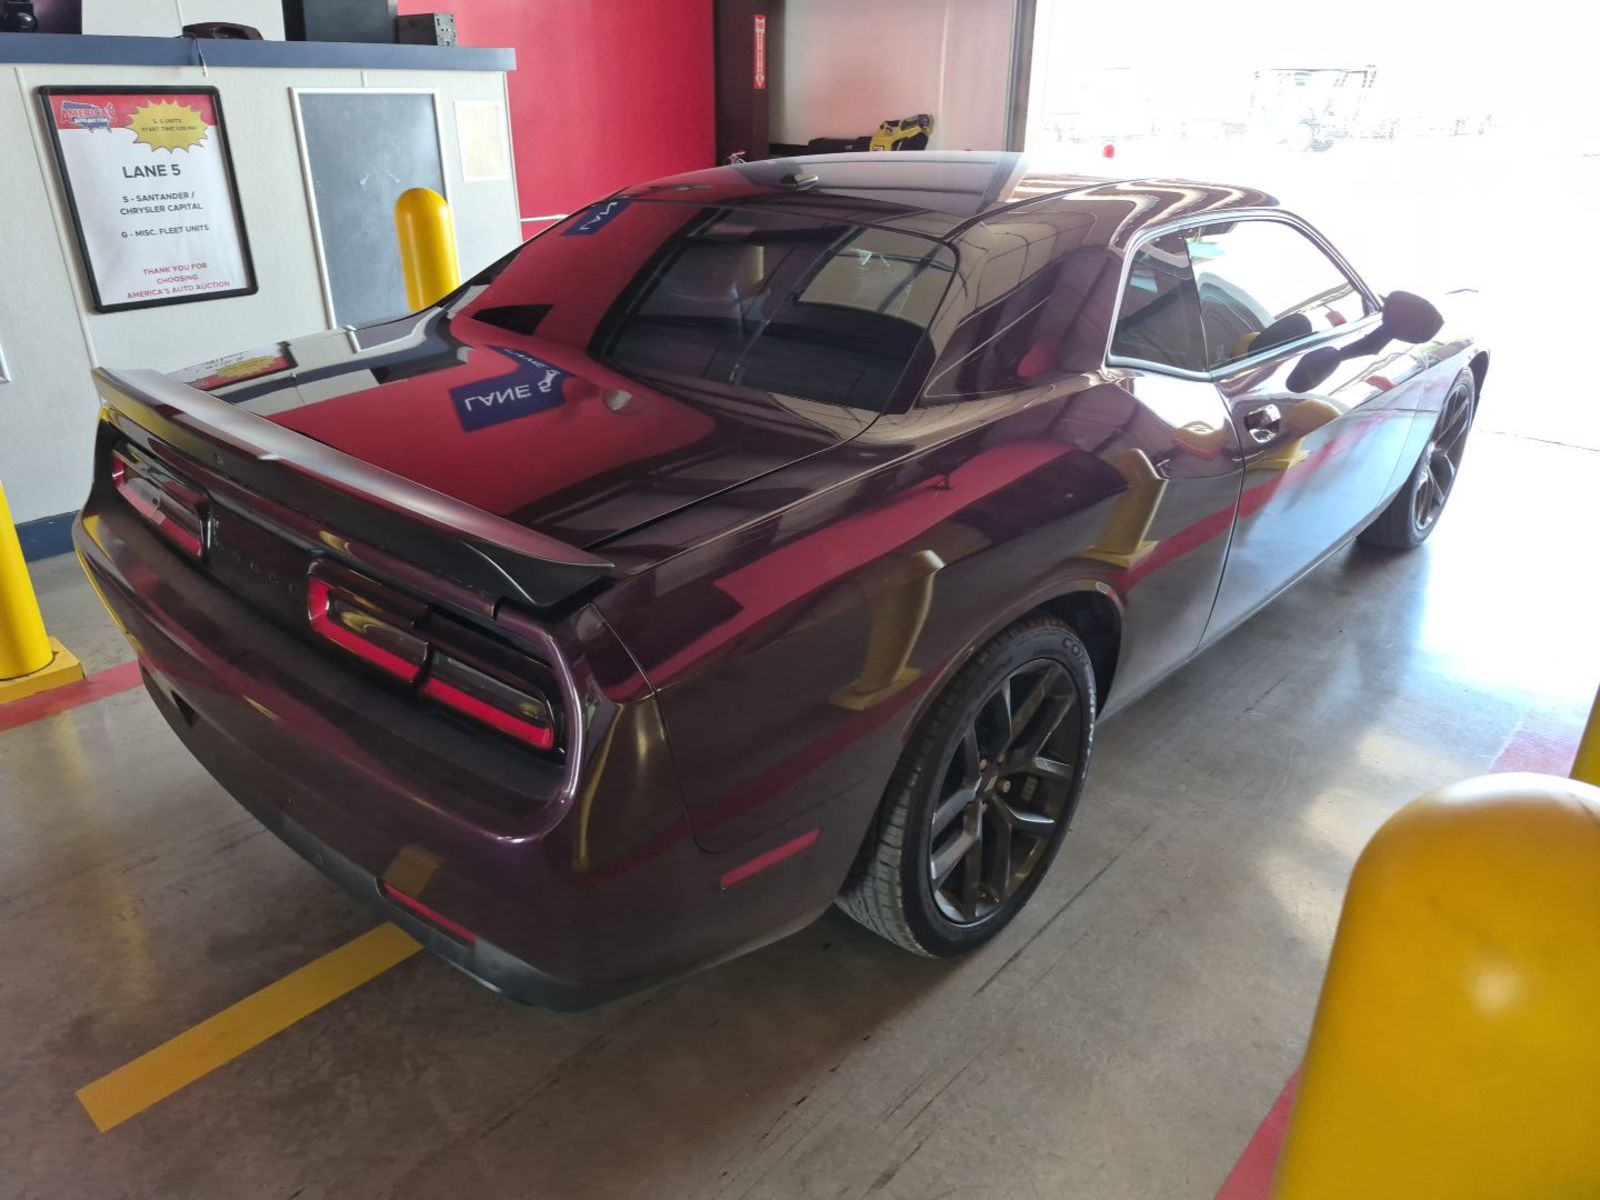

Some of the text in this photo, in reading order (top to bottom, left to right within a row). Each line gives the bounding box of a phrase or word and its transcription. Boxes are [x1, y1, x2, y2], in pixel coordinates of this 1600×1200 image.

[122, 163, 181, 178] LANE 5
[136, 192, 190, 202] SANTANDER
[120, 203, 203, 215] CHRYSLER CAPITAL
[135, 229, 158, 237] MISC.
[159, 226, 183, 235] FLEET
[185, 224, 210, 232] UNITS
[143, 262, 208, 275] THANK YOU FOR
[156, 274, 199, 284] CHOOSING
[127, 281, 230, 299] AMERICA'S AUTO AUCTION
